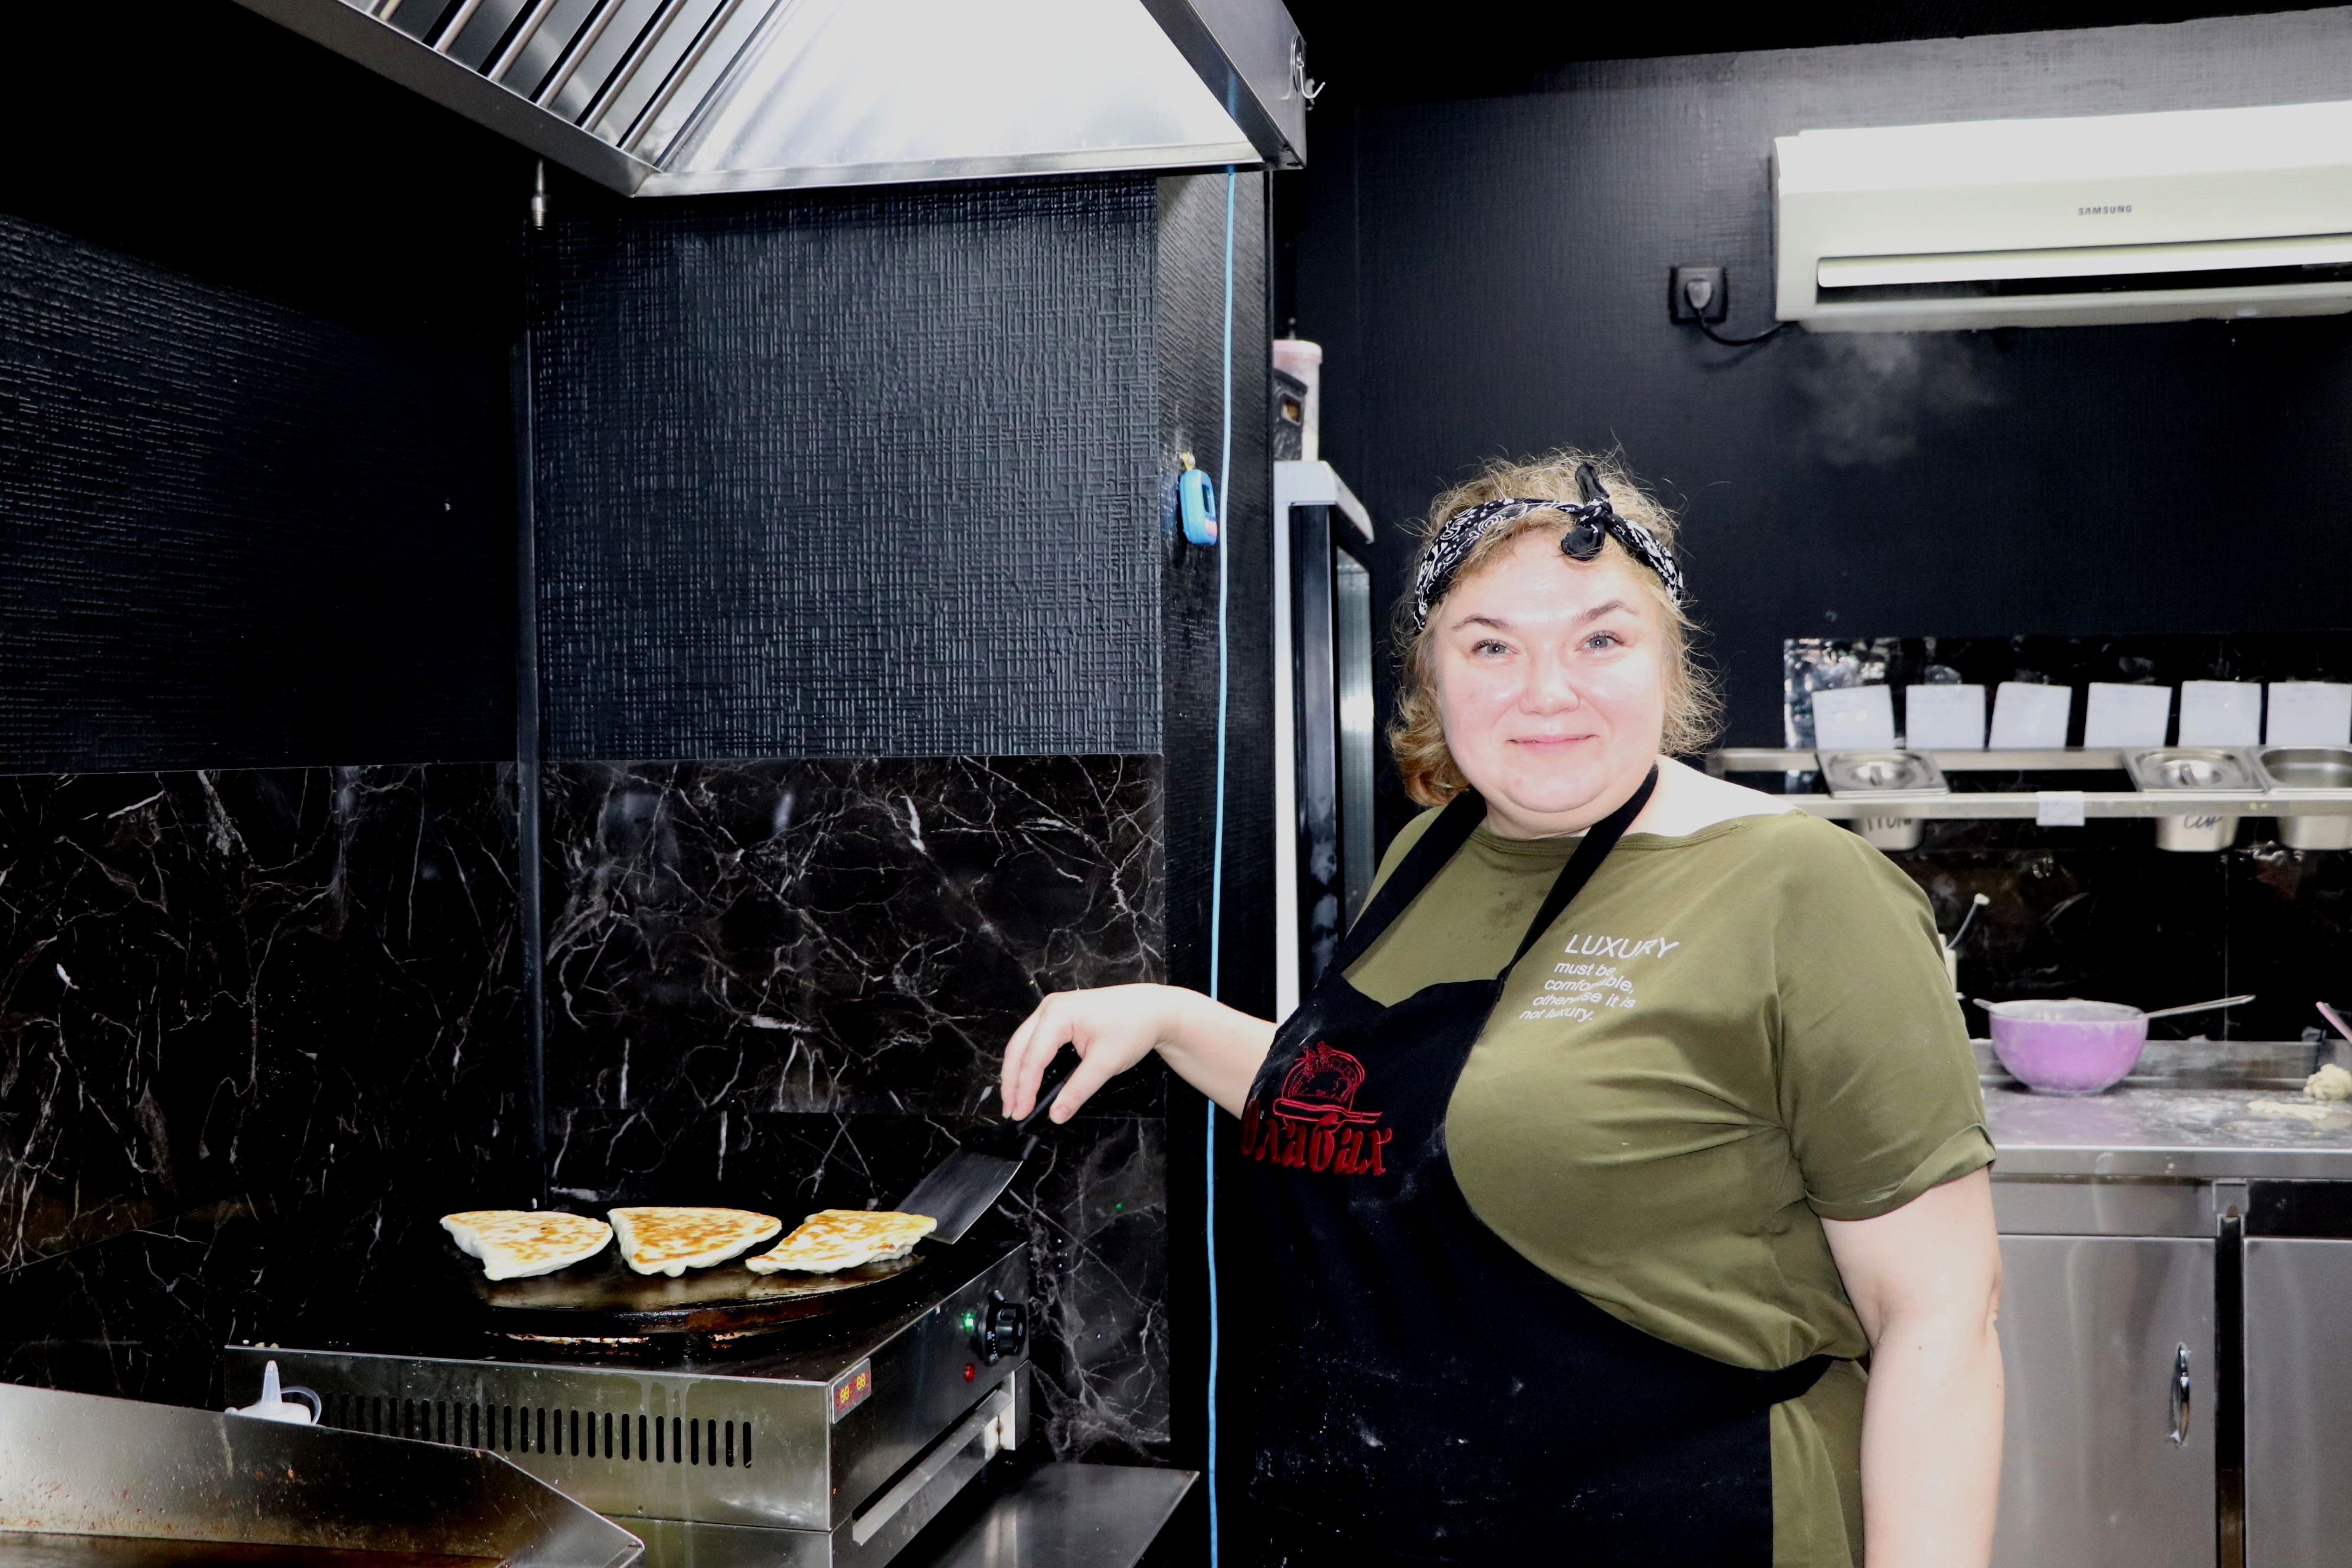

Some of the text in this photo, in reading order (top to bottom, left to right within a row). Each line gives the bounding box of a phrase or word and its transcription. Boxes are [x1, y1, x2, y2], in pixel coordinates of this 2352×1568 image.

[2078, 205, 2132, 215] SAMSUNG
[1564, 934, 1680, 959] LUXURY
[1553, 962, 1616, 976] must be
[1544, 975, 1634, 994] comforable,
[1533, 992, 1636, 1008] otherse it is
[1519, 1009, 1546, 1020] not
